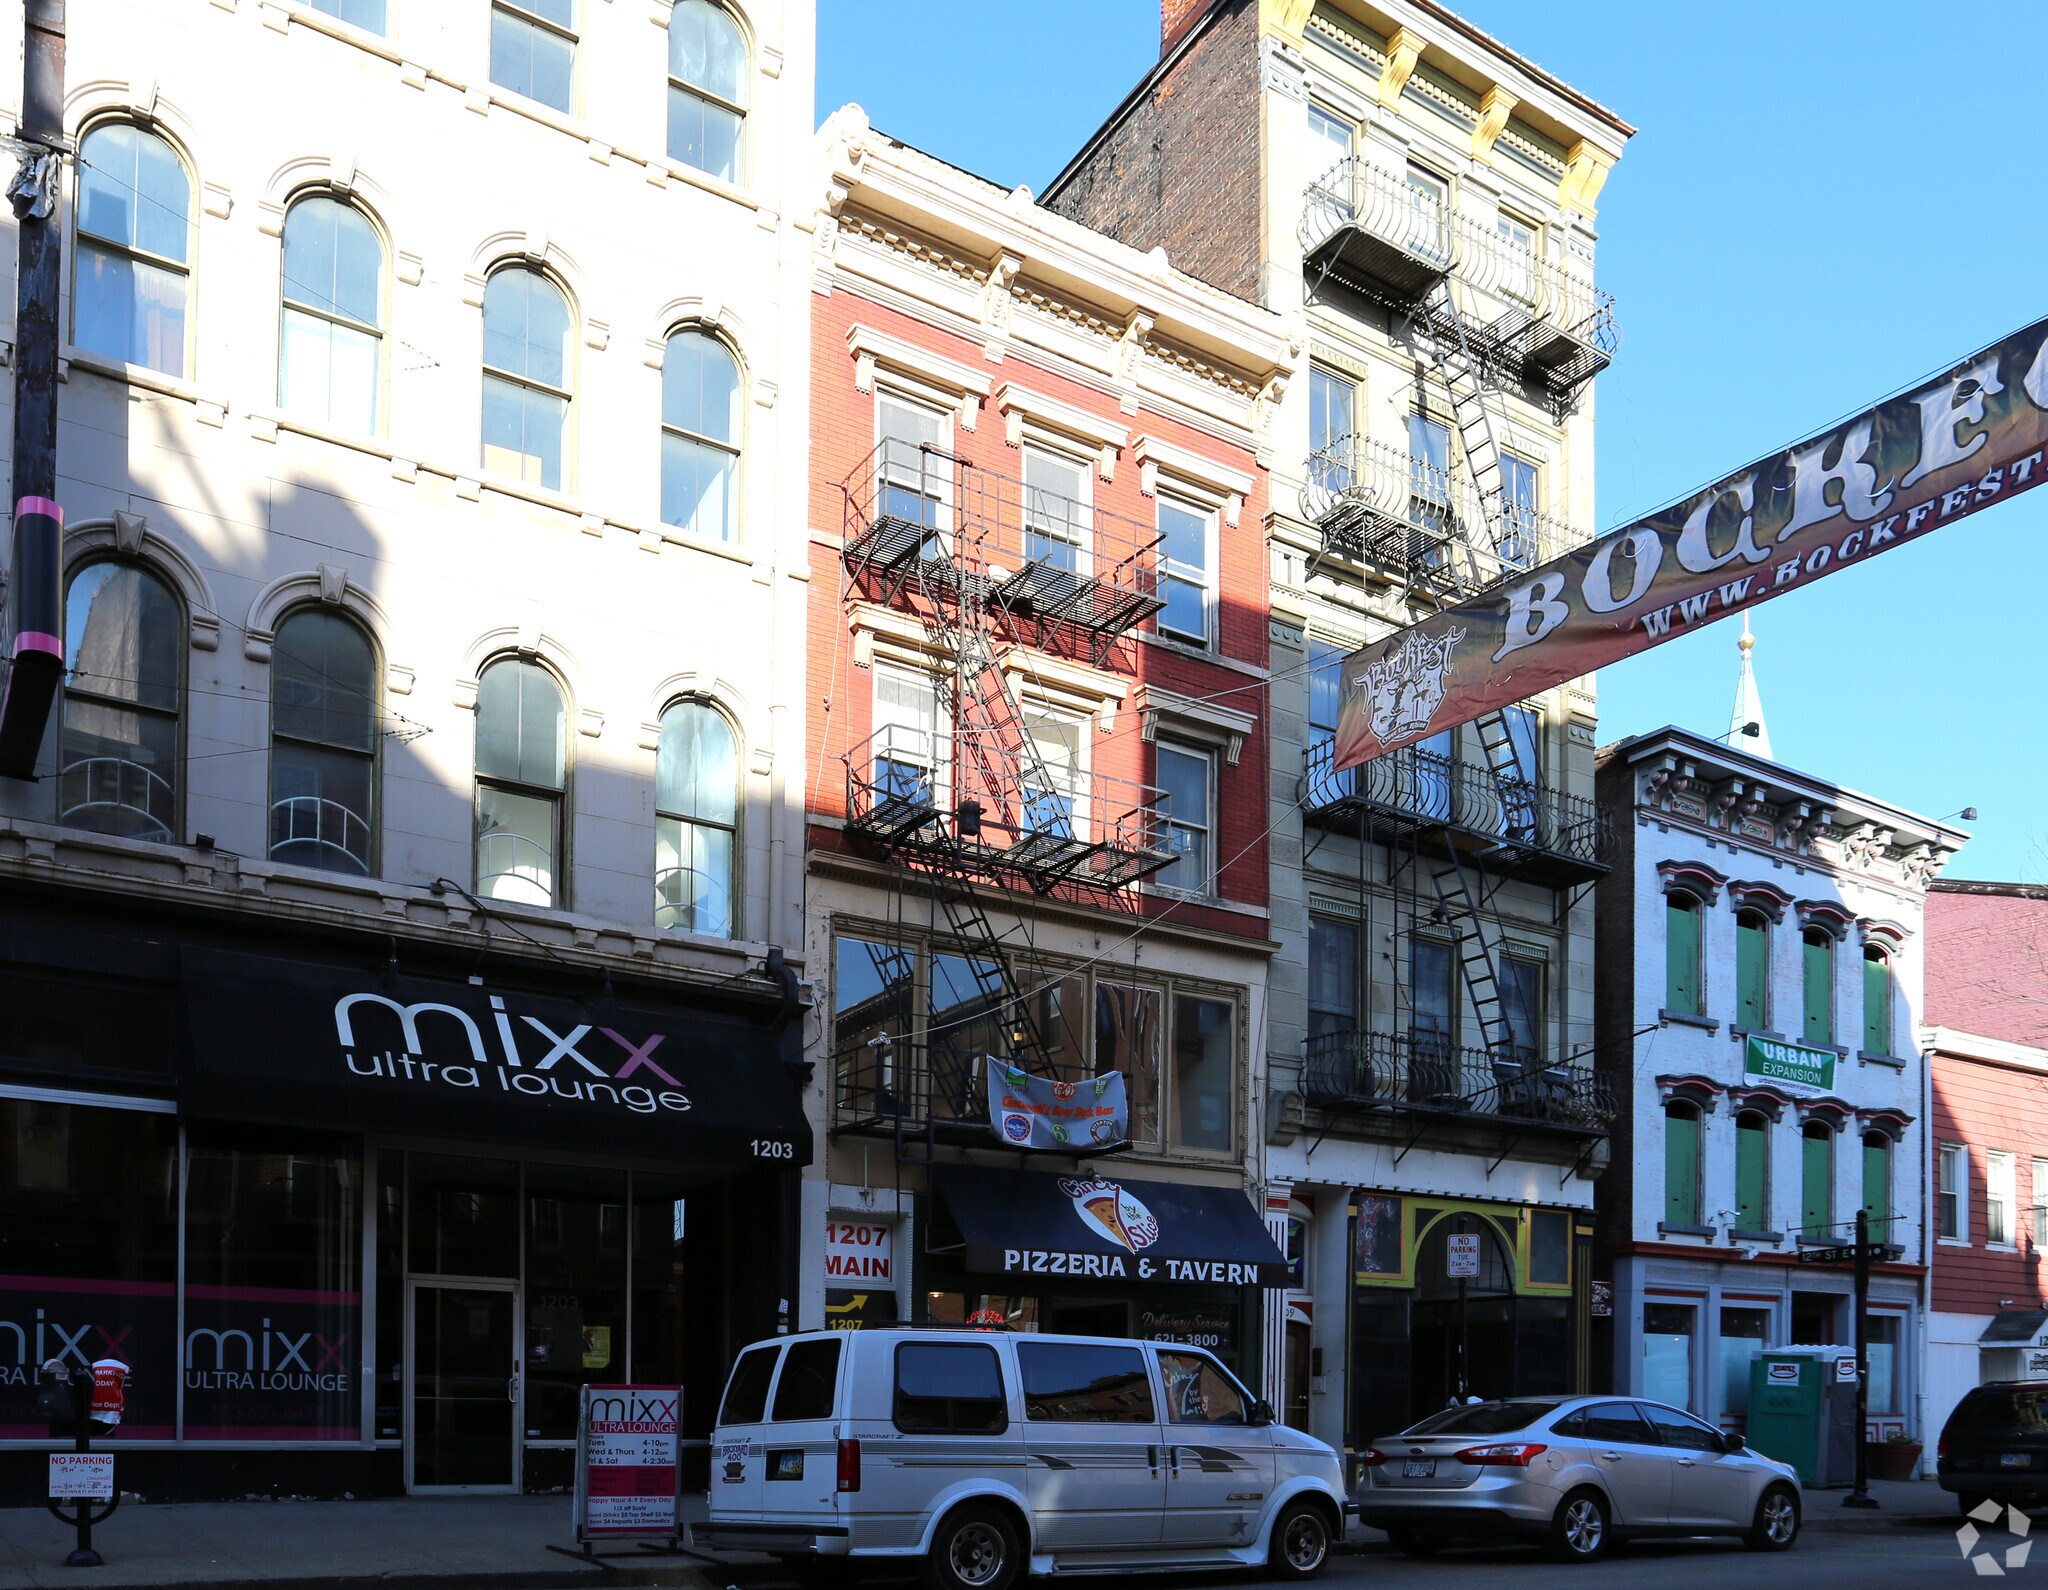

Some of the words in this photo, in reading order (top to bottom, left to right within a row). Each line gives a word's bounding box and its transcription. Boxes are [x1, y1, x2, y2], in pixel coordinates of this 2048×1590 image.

[1409, 721, 1427, 730] Rhine
[335, 992, 683, 1087] mixx
[1763, 1042, 1822, 1069] URBAN
[346, 1051, 481, 1088] ultra
[497, 1065, 692, 1114] lounge
[1763, 1062, 1822, 1084] EXPANSION
[750, 1139, 793, 1159] 1203
[1120, 1203, 1136, 1214] by
[1127, 1212, 1142, 1221] the
[826, 1223, 888, 1247] 1207
[1127, 1215, 1158, 1248] Slice
[1458, 1237, 1470, 1246] NO
[1451, 1245, 1477, 1254] PARKING
[1803, 1251, 1821, 1262] 12TH
[1826, 1250, 1838, 1260] ST
[1843, 1249, 1849, 1258] E
[825, 1255, 890, 1278] MAIN
[1004, 1249, 1126, 1278] PIZZERIA
[1138, 1258, 1157, 1279] &
[1166, 1260, 1258, 1285] TAVERN
[540, 1295, 578, 1309] 1203
[829, 1319, 863, 1331] 1207
[1142, 1311, 1190, 1333] Delivery
[1192, 1314, 1230, 1328] Service
[186, 1317, 348, 1372] mixx
[186, 1371, 255, 1390] ULTRA
[260, 1372, 348, 1391] LOUNGE
[590, 1391, 677, 1422] mixx
[589, 1422, 625, 1433] ULTRA
[627, 1422, 676, 1433] LOUNGE
[51, 1456, 66, 1464] NO
[69, 1456, 112, 1465] PARKING
[727, 1453, 742, 1461] 400
